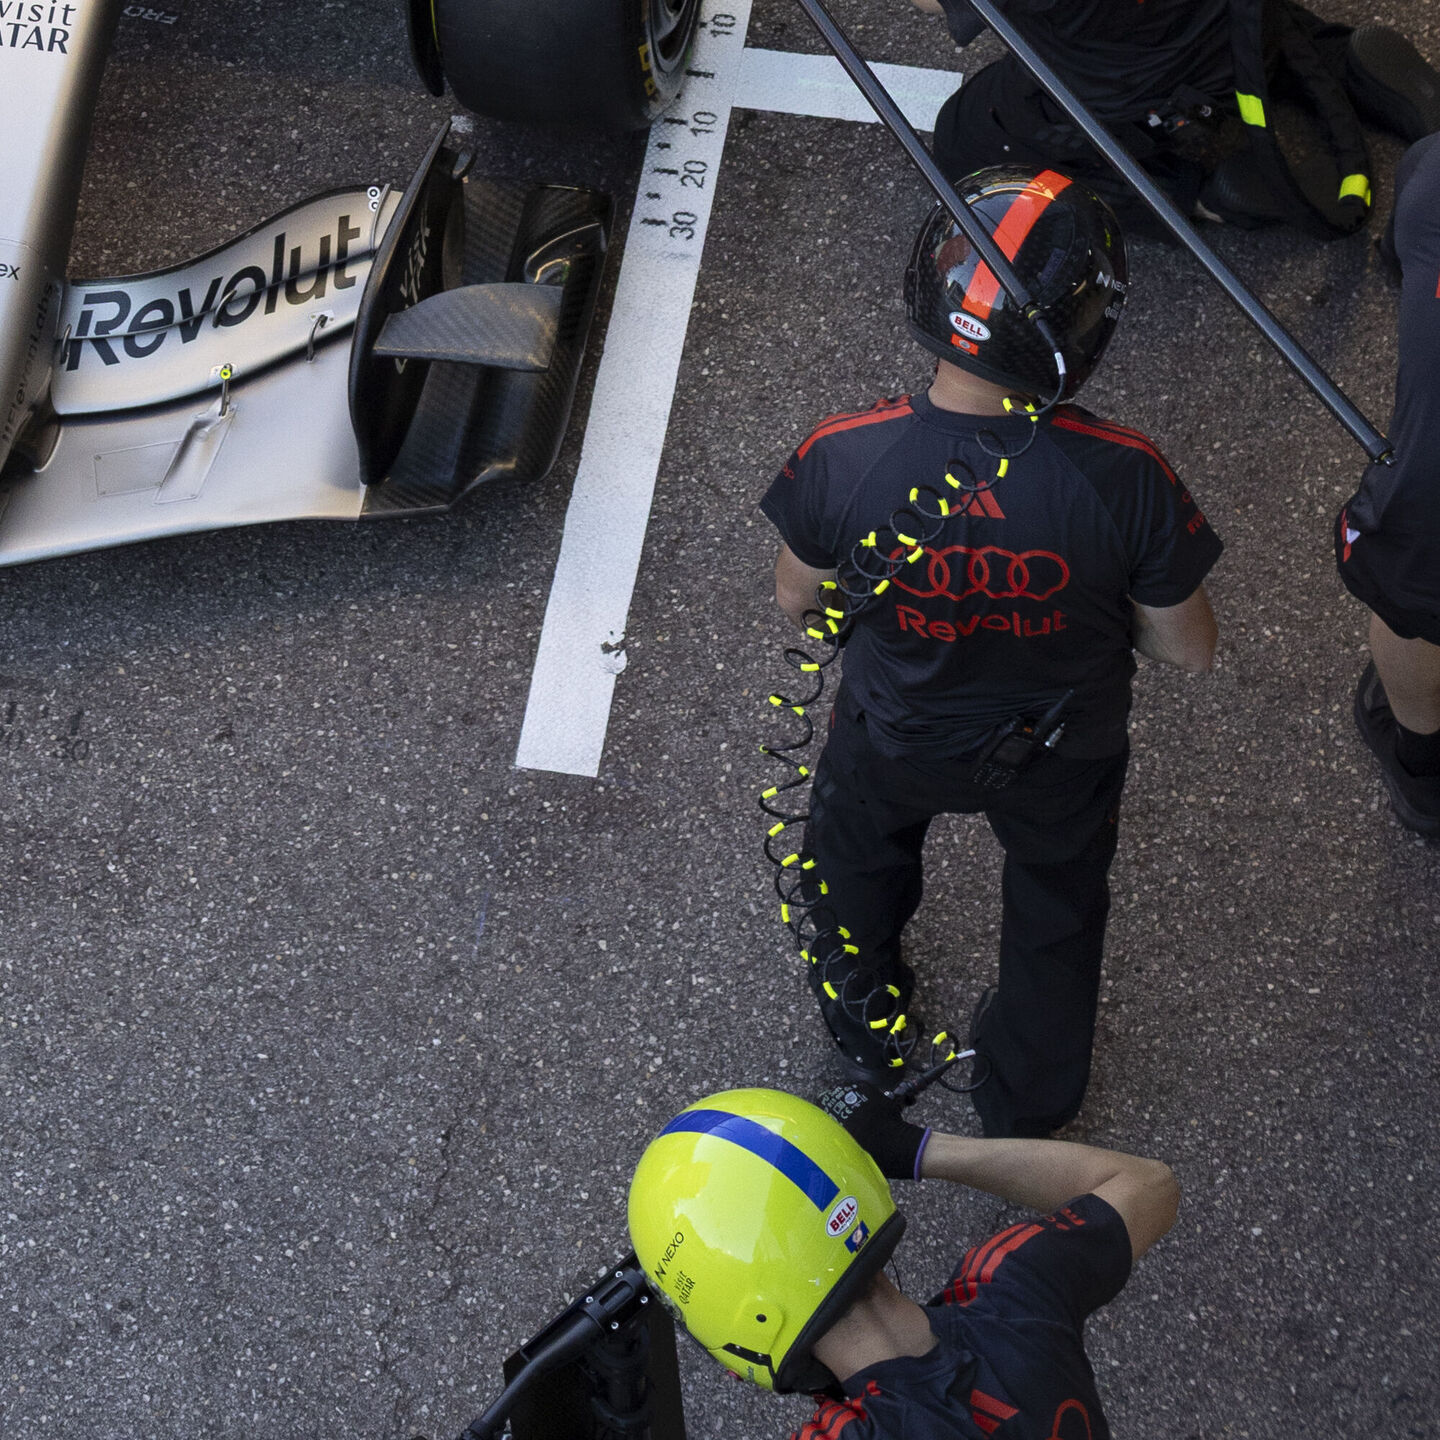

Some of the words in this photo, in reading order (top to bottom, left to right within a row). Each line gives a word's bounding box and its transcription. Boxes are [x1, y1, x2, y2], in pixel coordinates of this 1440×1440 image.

[710, 14, 736, 37] 10
[689, 110, 718, 137] 10
[680, 160, 708, 189] 20
[669, 211, 698, 240] 30
[65, 214, 361, 372] Revolut
[954, 315, 984, 338] BELL
[896, 604, 1068, 642] Revolut
[830, 1202, 856, 1233] BELL
[661, 1231, 685, 1267] NEXO
[678, 1276, 696, 1305] QATAR
